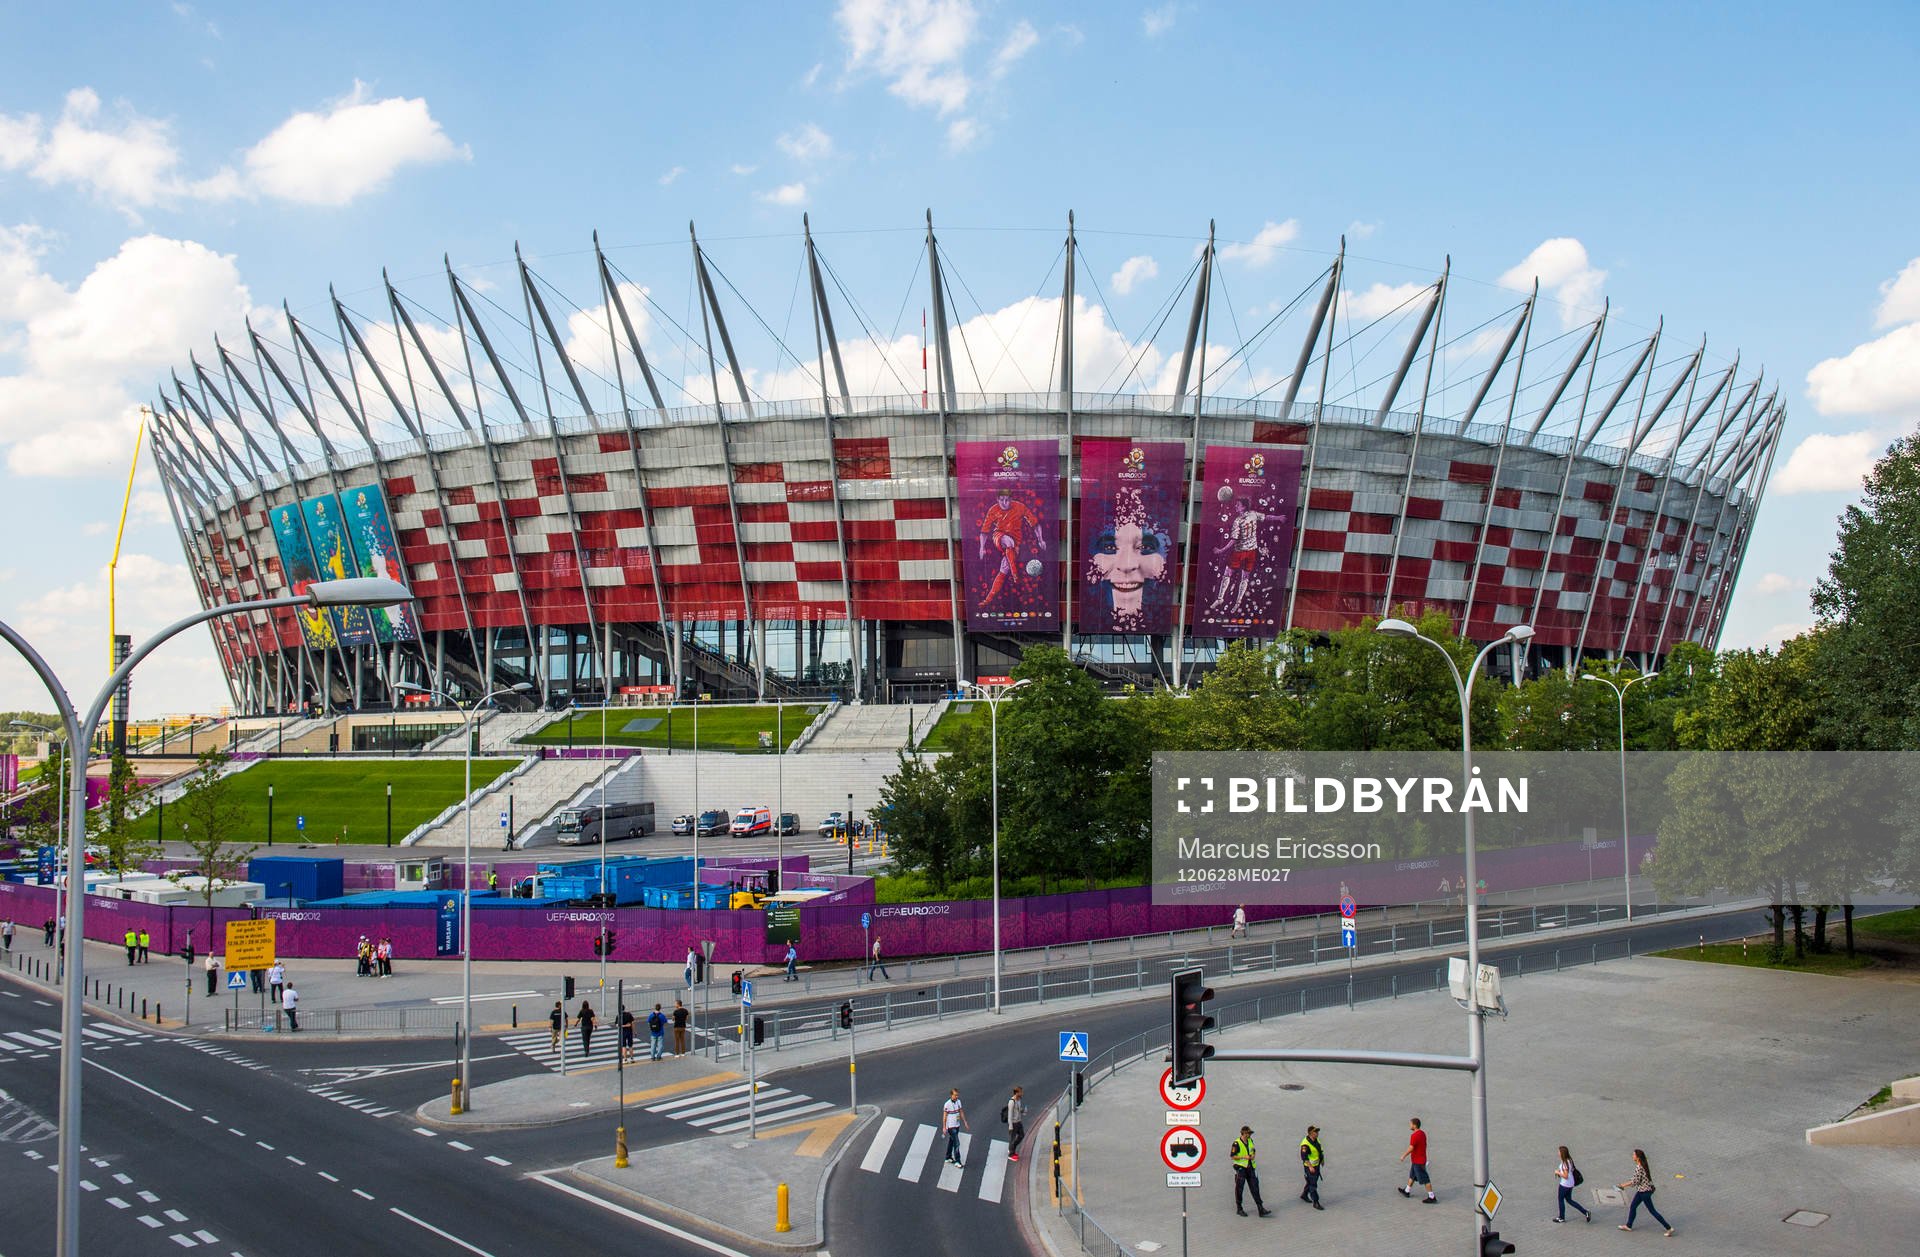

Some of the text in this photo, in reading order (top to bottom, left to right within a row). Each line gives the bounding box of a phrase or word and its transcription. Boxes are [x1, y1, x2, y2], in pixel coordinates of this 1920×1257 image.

[874, 904, 950, 918] UEFAEURO2012
[546, 912, 615, 922] UEFAEURO2012
[1175, 1092, 1191, 1102] 2,5t
